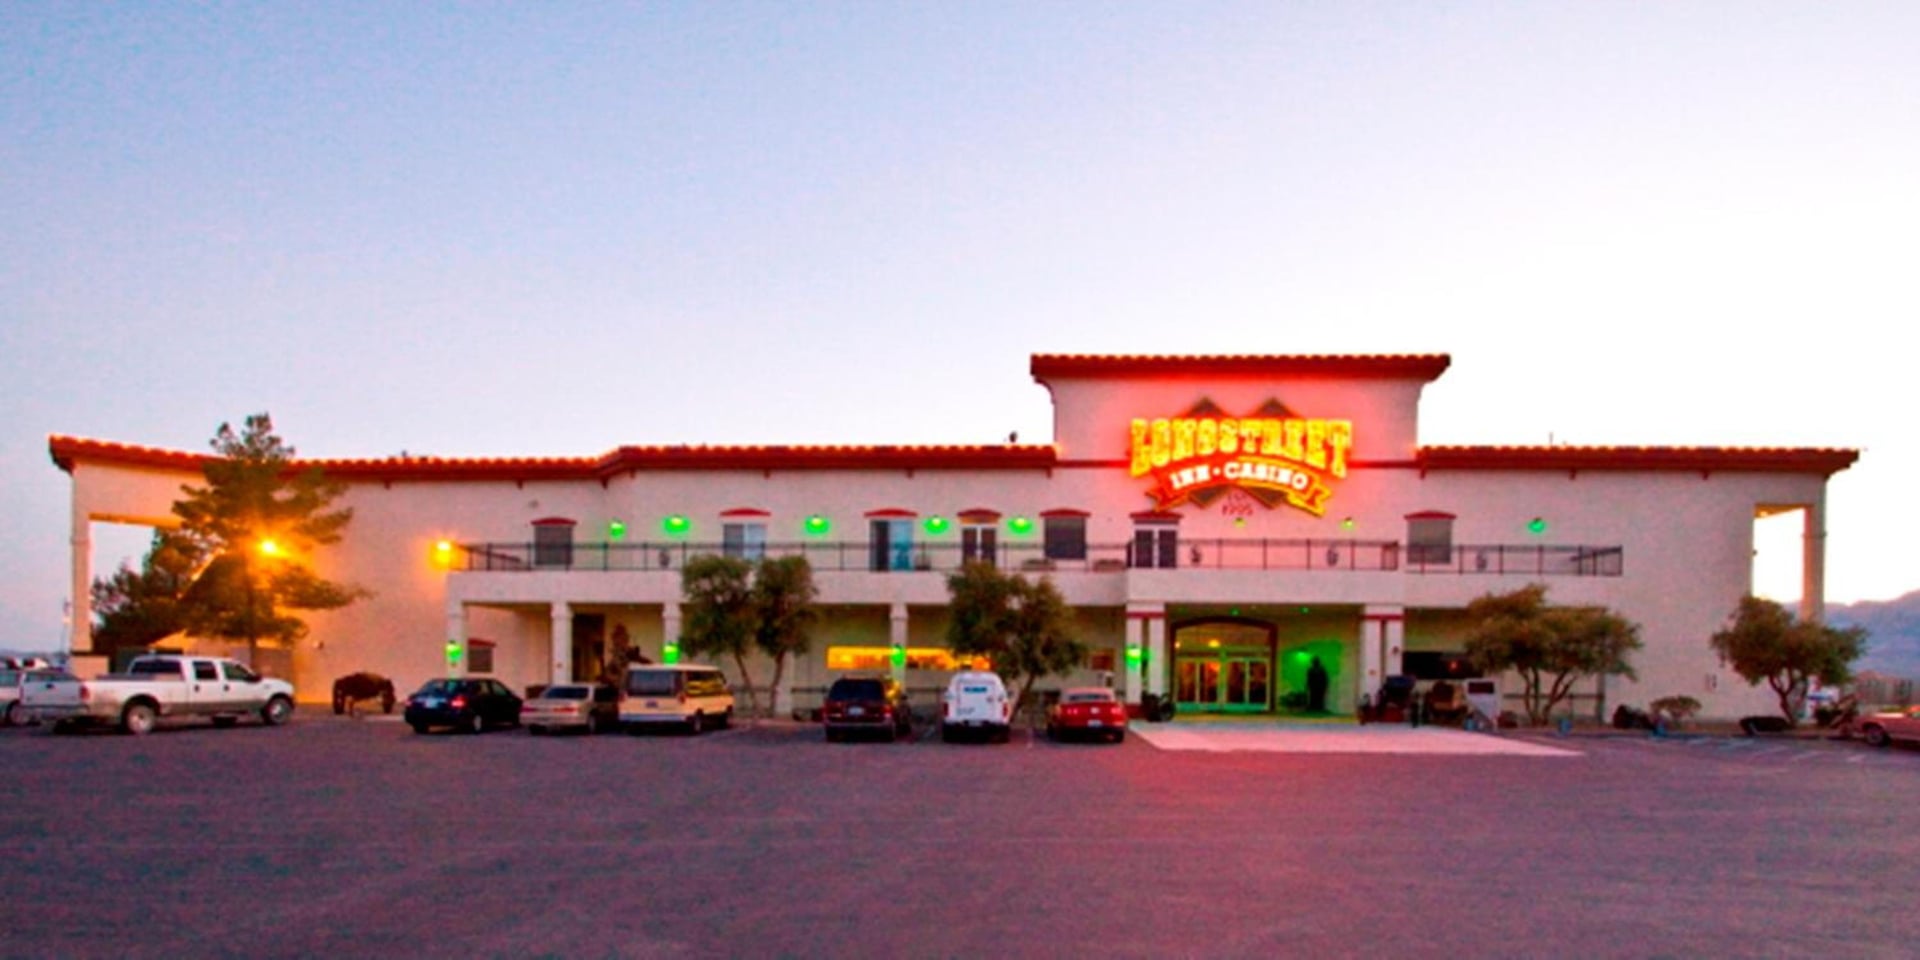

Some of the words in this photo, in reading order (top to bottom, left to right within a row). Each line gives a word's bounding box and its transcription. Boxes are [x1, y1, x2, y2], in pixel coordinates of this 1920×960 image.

[1130, 418, 1352, 478] LONGSTREET
[1169, 464, 1211, 490] INN
[1223, 461, 1309, 490] CASINO
